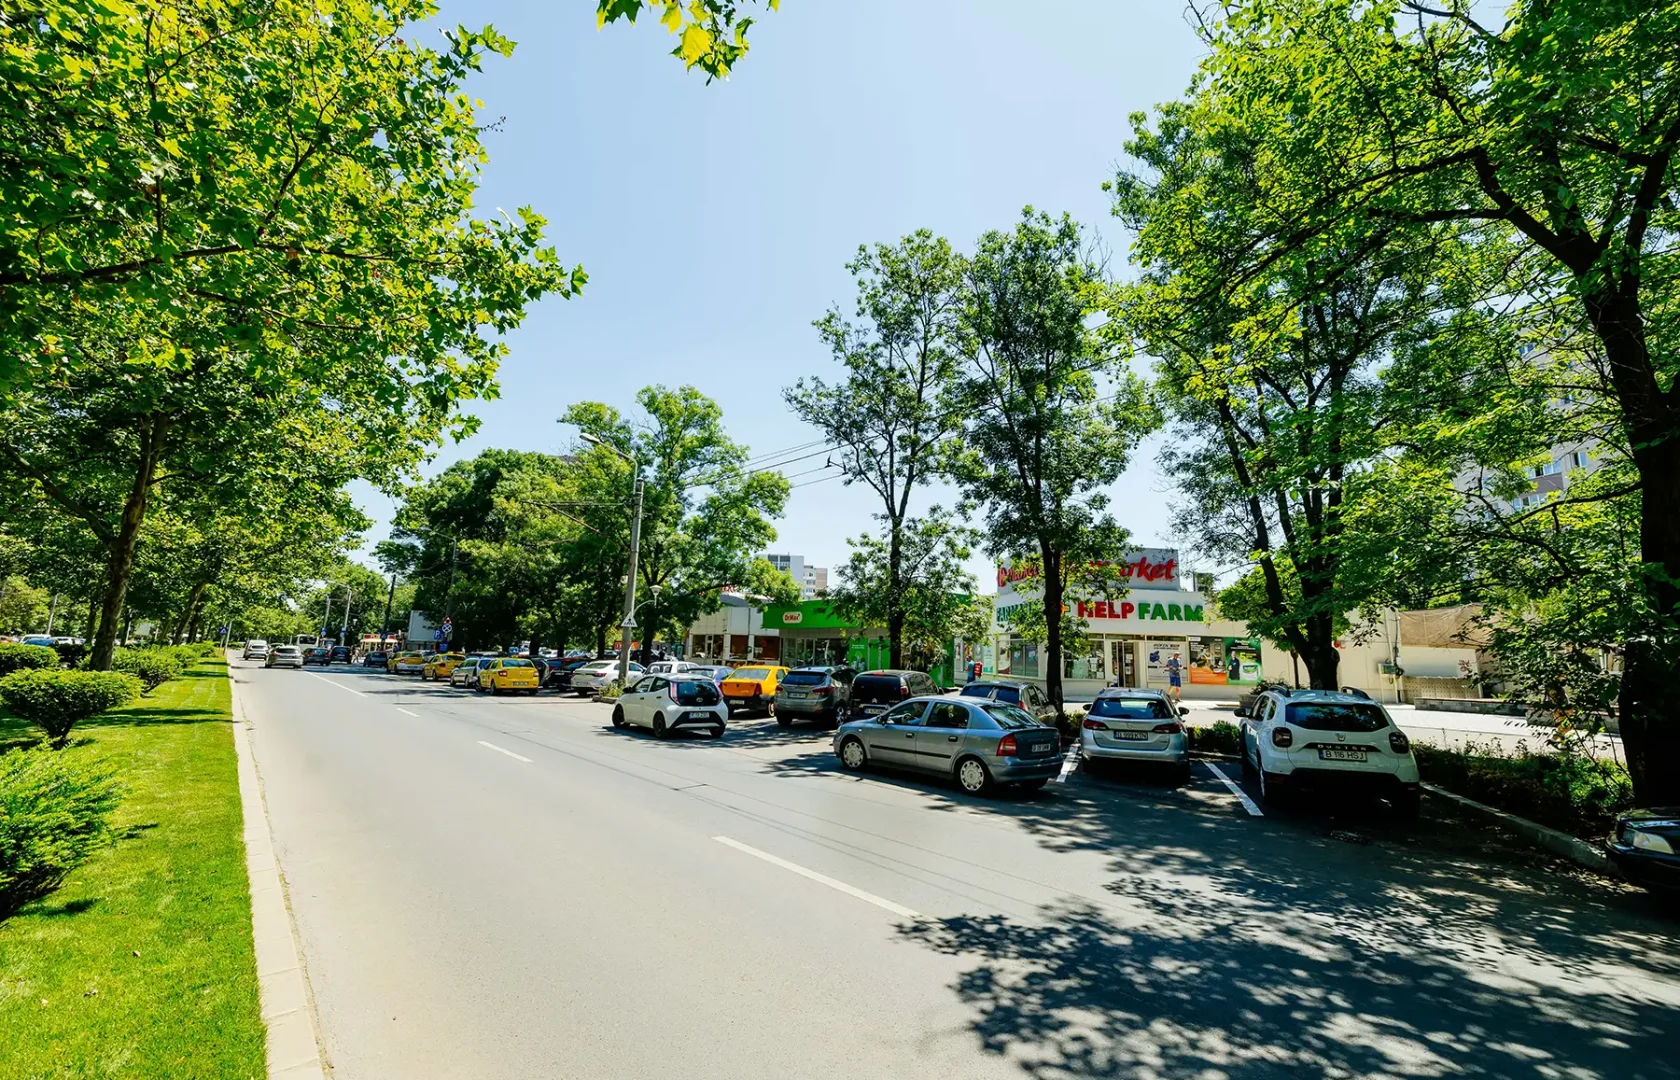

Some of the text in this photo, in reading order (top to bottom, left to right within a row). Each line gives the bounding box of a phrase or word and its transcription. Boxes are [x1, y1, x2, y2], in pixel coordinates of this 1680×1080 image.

[1077, 600, 1204, 622] HELP FARM
[1325, 750, 1332, 758] B
[1347, 751, 1364, 760] HSJ
